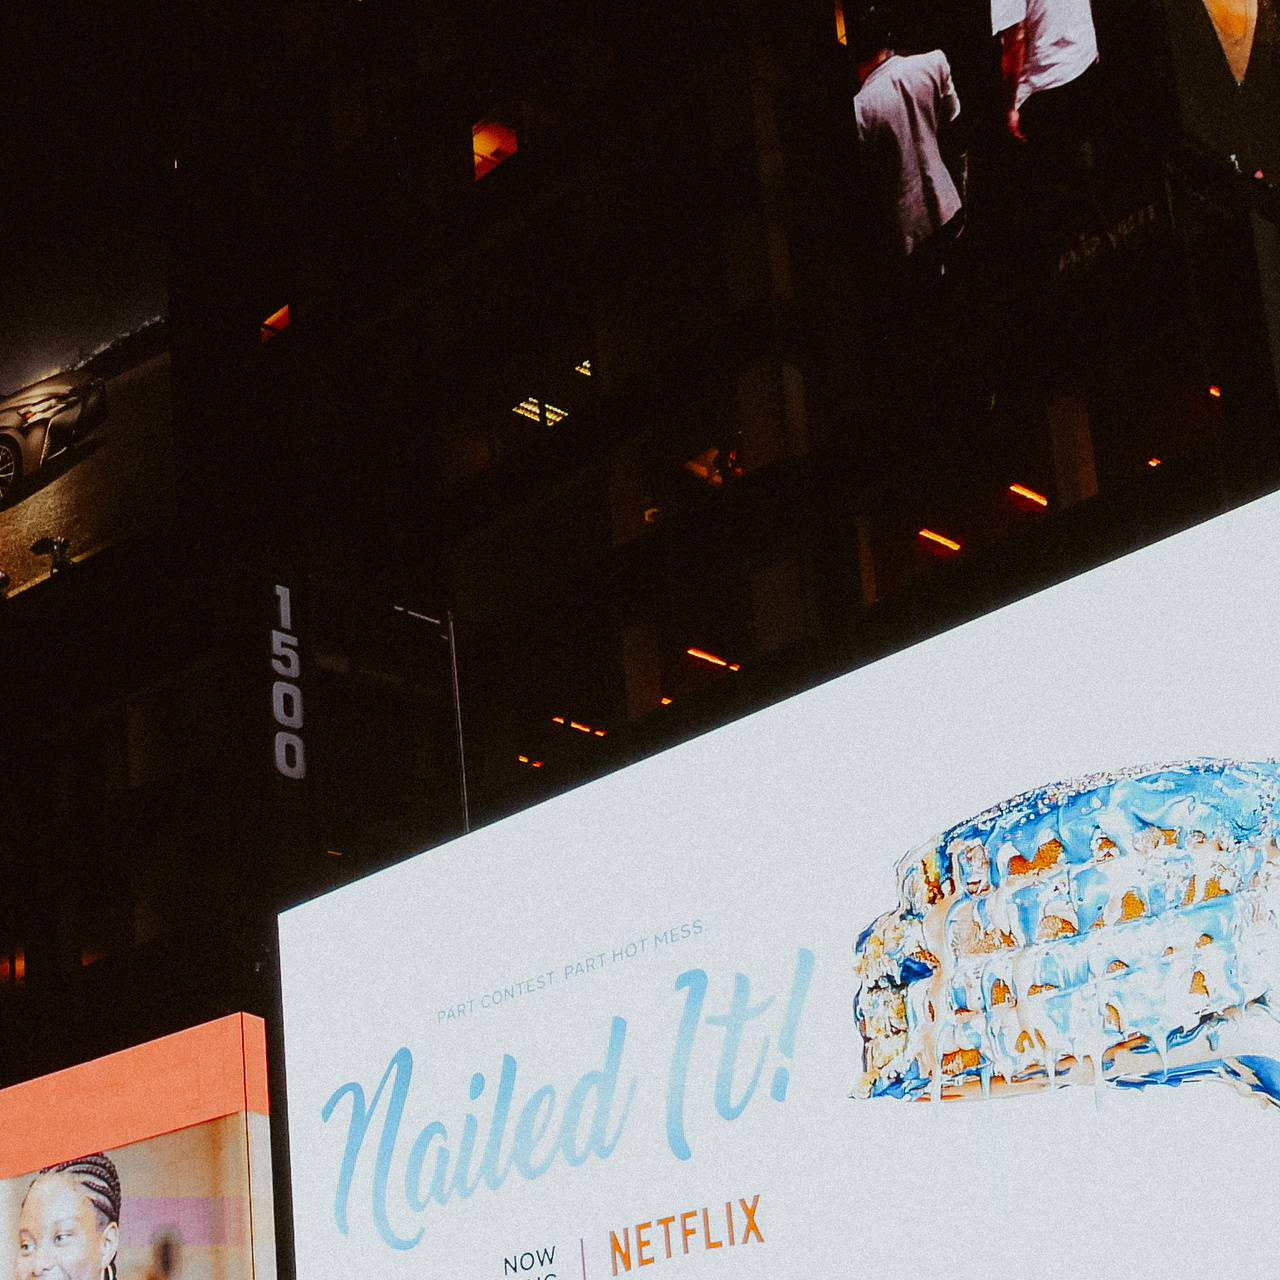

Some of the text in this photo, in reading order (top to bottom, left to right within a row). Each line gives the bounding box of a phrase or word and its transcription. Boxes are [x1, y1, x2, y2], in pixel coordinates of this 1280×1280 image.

[271, 584, 306, 779] 1500
[437, 1000, 475, 1023] PART
[564, 953, 606, 979] PART
[612, 938, 647, 963] HOT
[321, 947, 815, 1251] Nailed It!
[503, 1246, 556, 1276] NOW
[609, 1194, 765, 1277] NETFLIX
